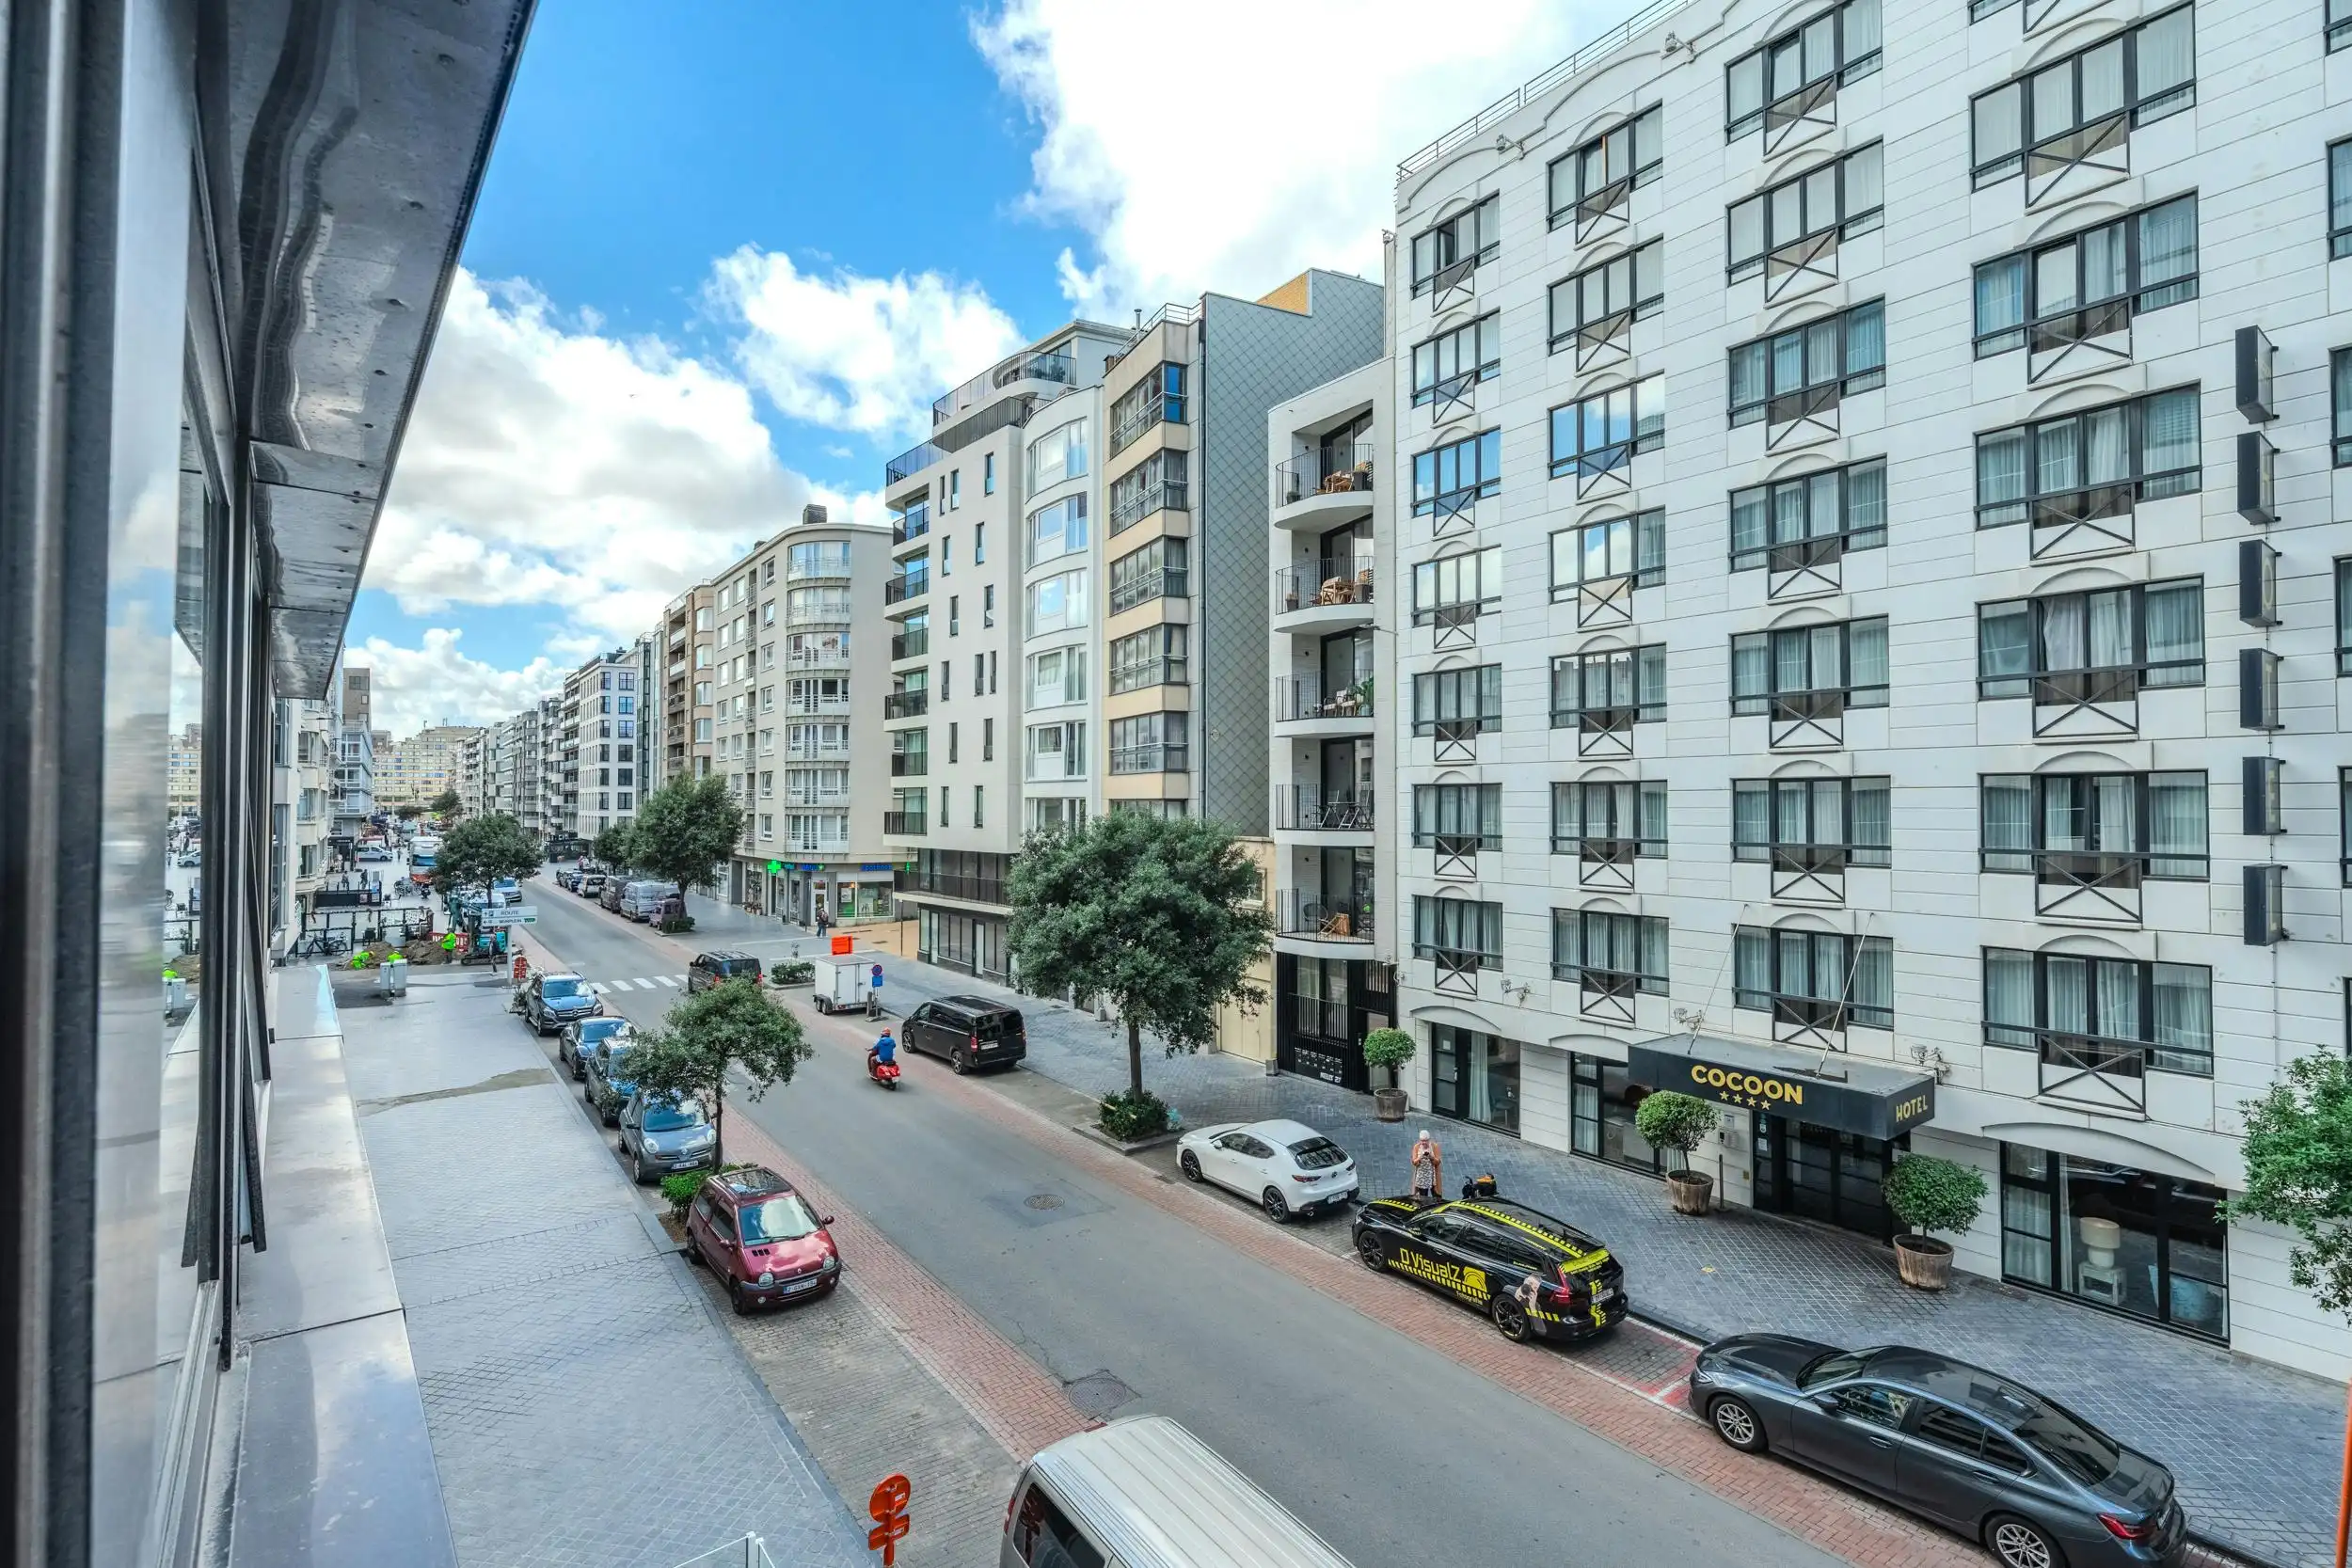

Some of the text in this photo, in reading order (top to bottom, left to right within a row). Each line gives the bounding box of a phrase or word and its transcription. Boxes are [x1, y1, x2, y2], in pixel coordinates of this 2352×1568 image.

[1691, 1065, 1803, 1105] COCOON
[1896, 1094, 1929, 1123] HOTEL
[1399, 1247, 1410, 1265] D
